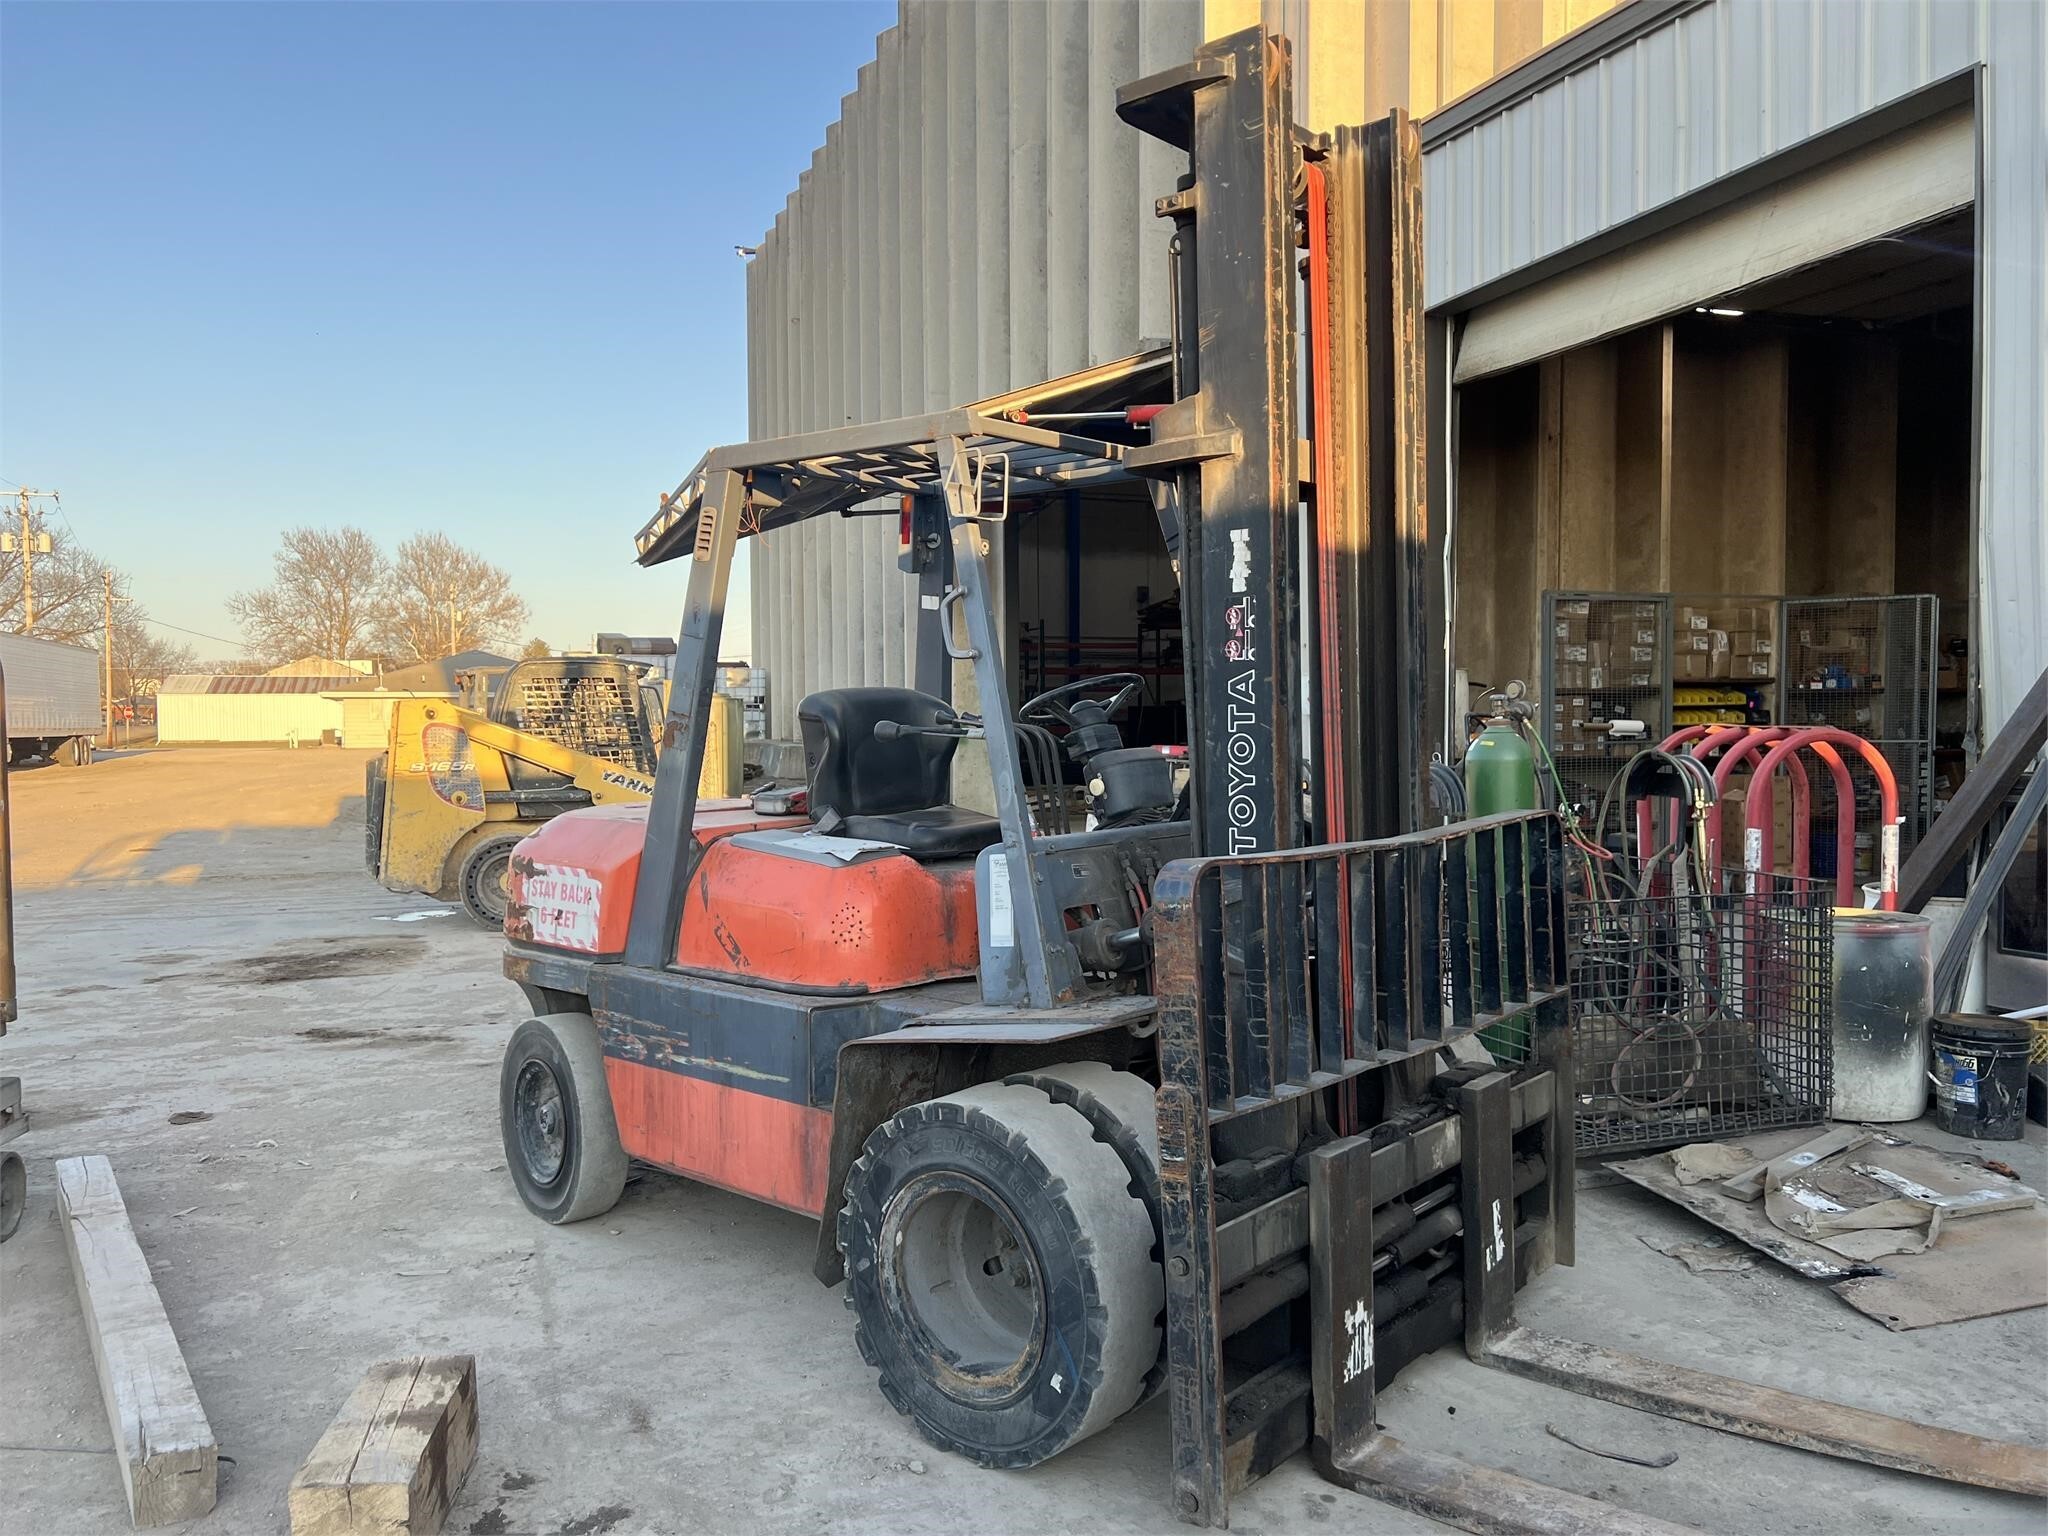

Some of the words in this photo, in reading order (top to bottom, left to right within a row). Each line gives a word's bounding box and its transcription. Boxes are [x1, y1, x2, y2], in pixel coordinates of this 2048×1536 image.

[1228, 669, 1257, 856] TOYOTA
[602, 771, 654, 796] YANM
[531, 879, 557, 899] STAY
[561, 882, 592, 905] BACK
[541, 906, 548, 924] 6
